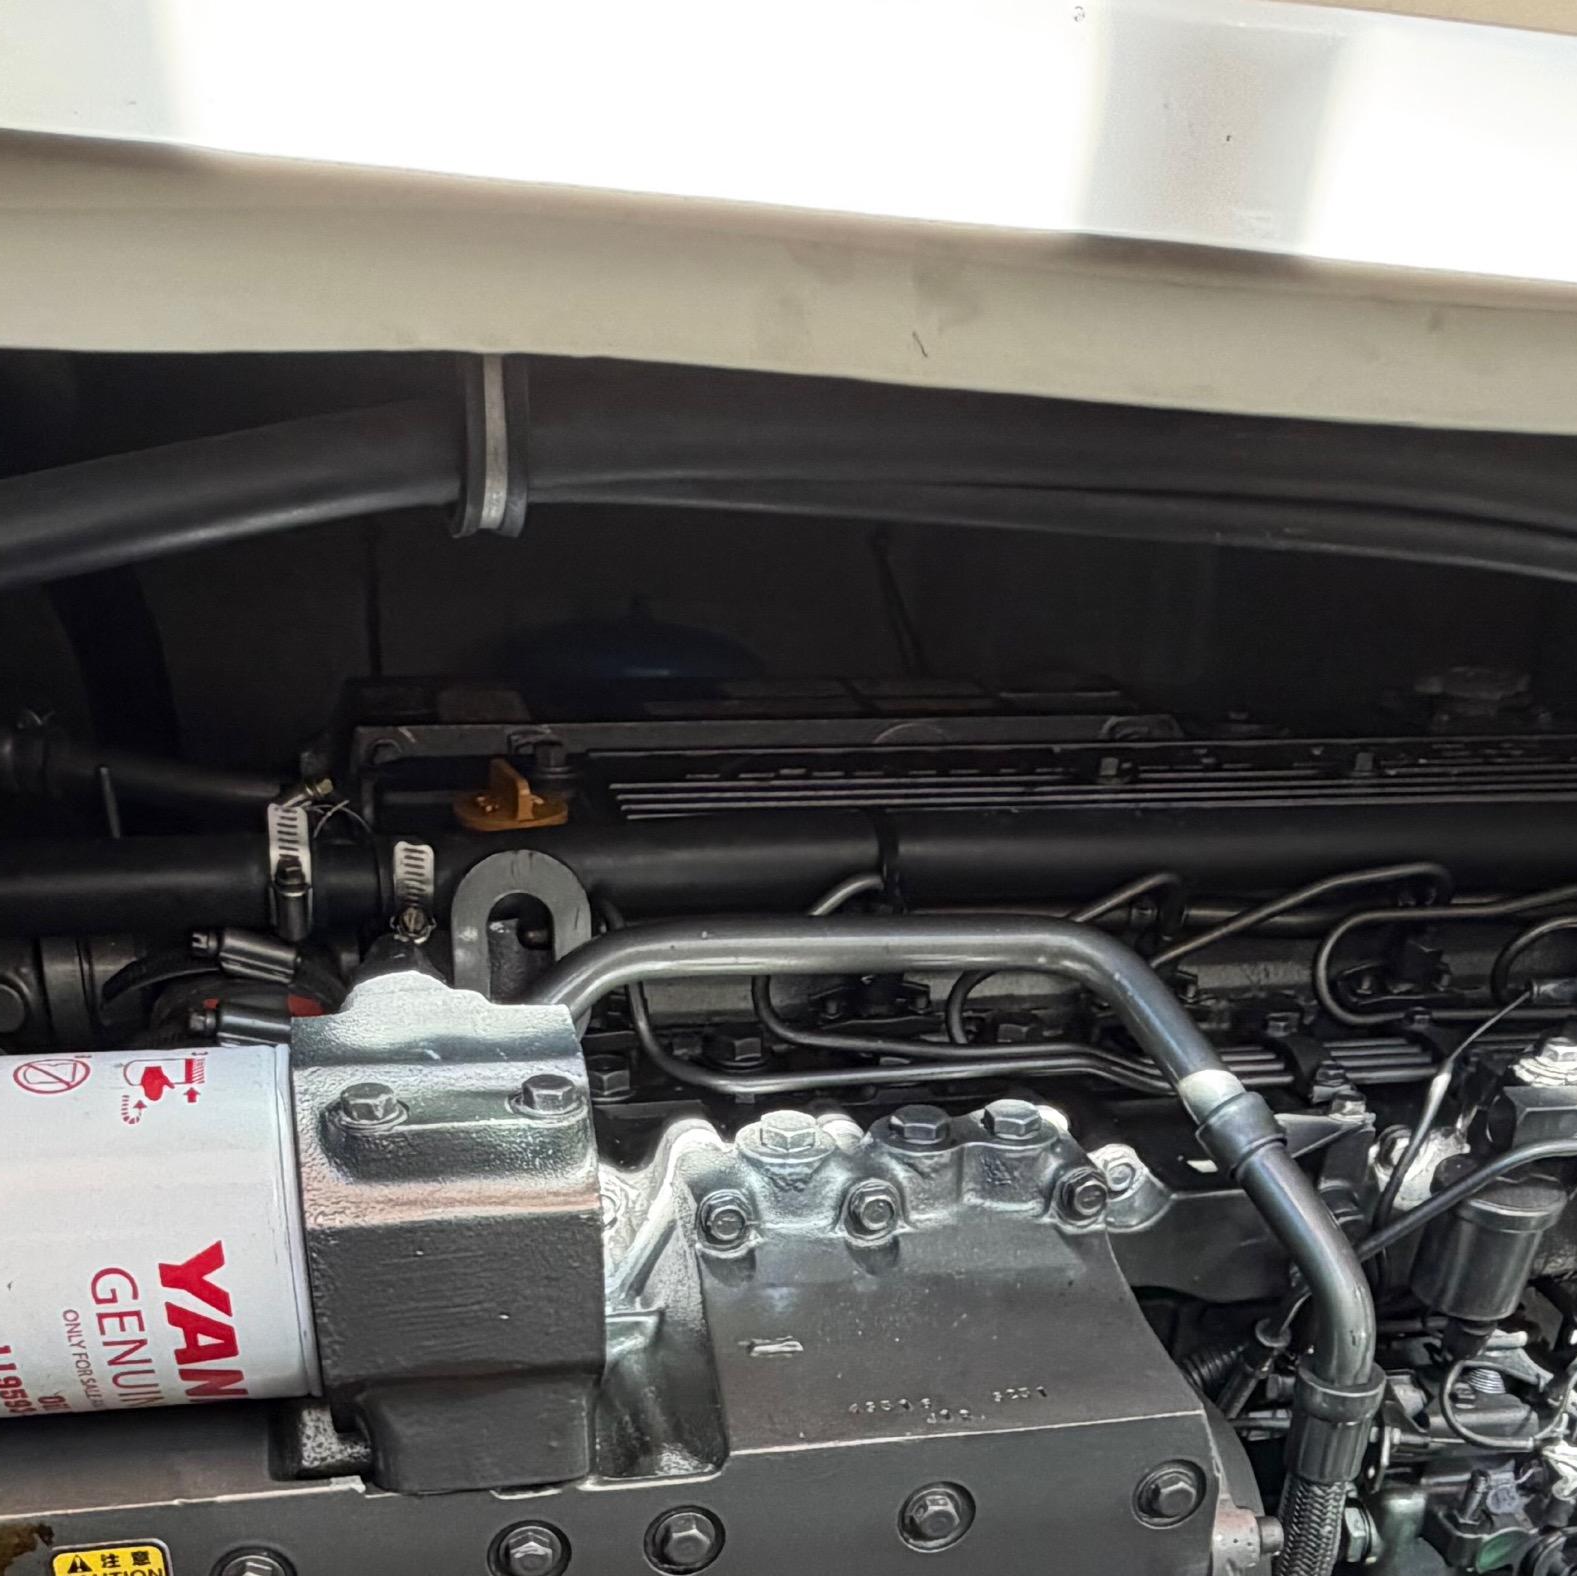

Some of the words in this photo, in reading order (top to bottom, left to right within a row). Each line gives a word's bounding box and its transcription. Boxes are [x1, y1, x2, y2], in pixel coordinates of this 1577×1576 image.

[62, 1308, 86, 1350] ONLY
[158, 1240, 250, 1402] YAN
[72, 1350, 94, 1380] FOR
